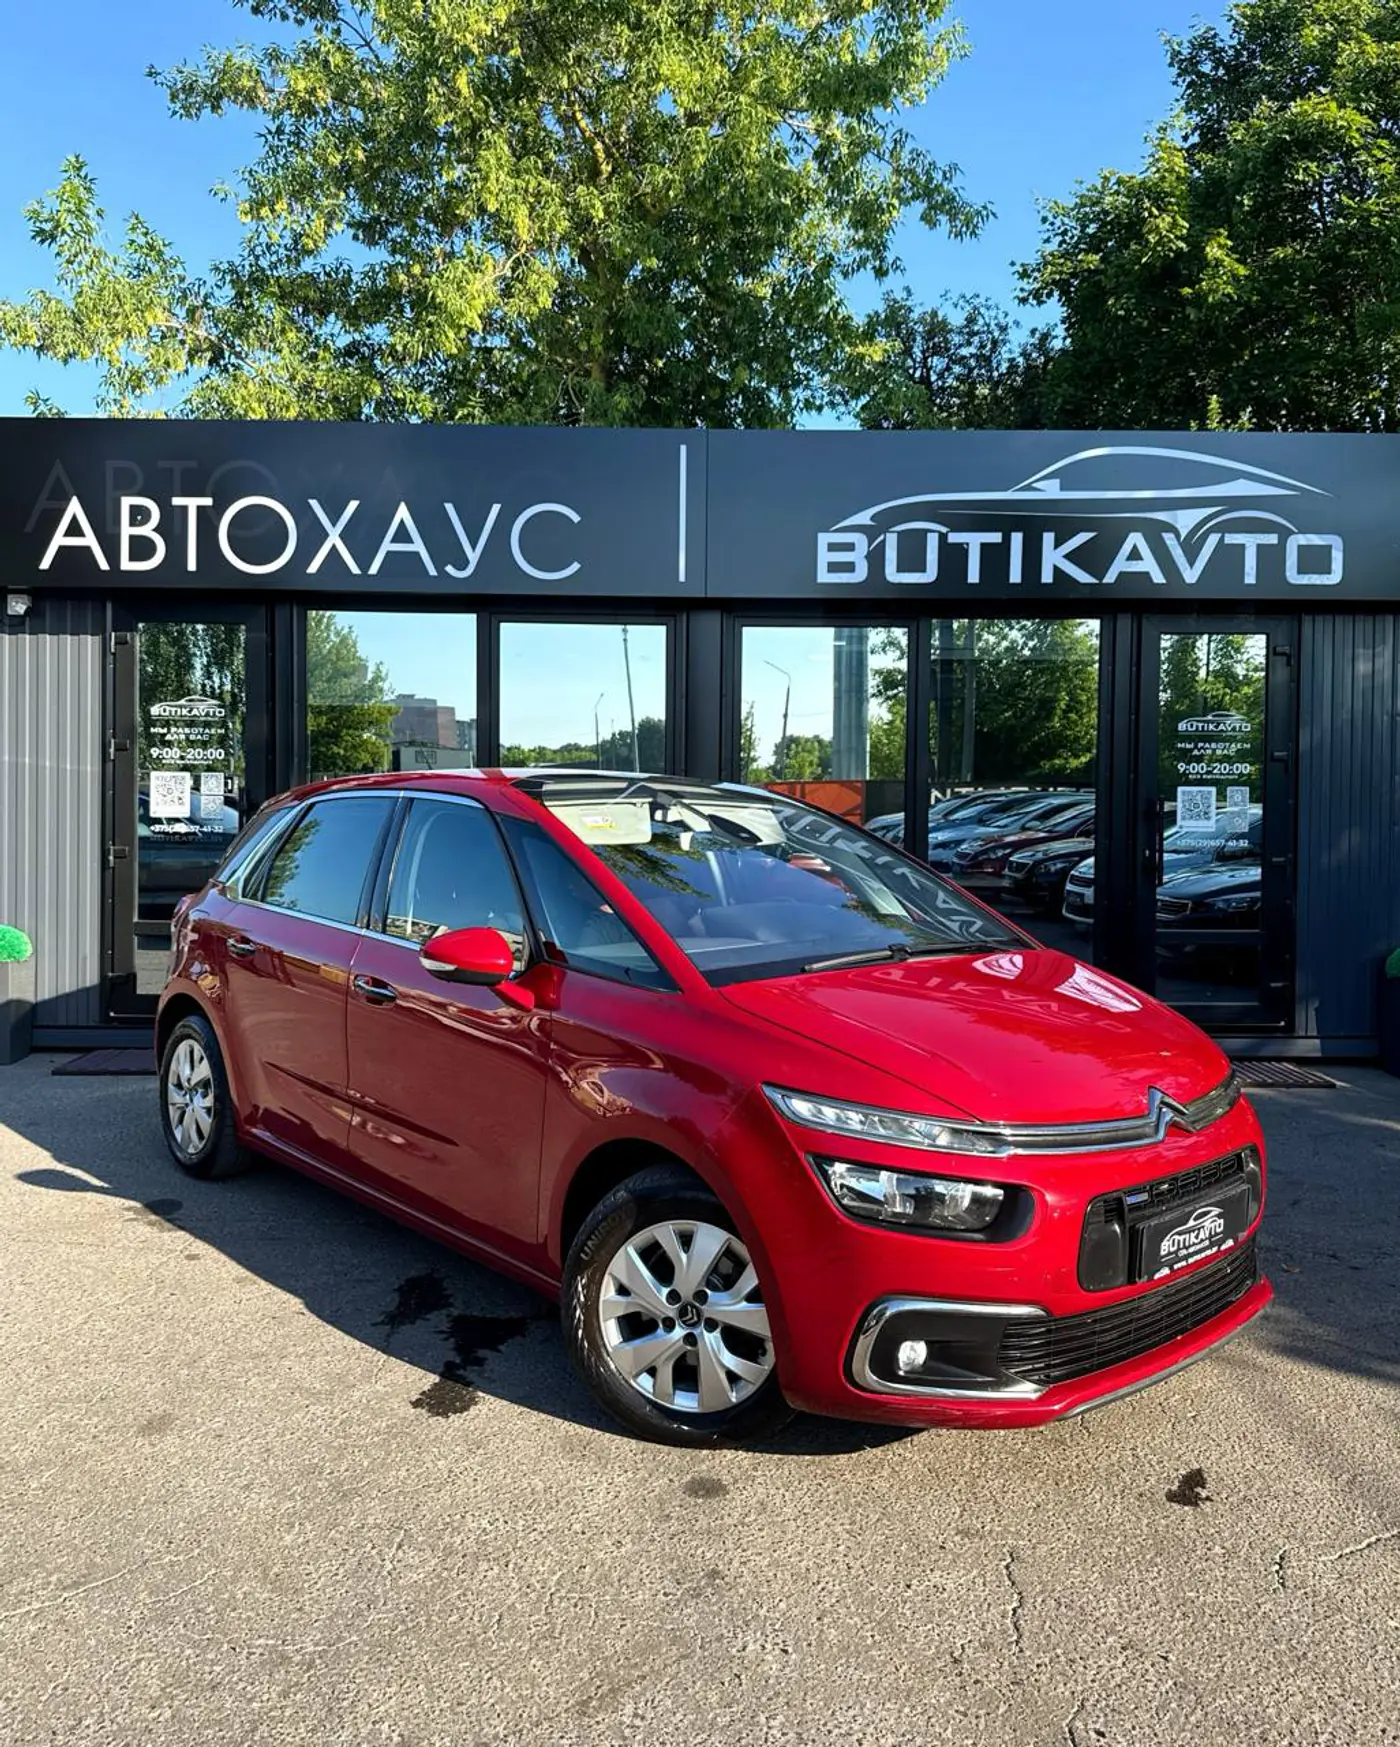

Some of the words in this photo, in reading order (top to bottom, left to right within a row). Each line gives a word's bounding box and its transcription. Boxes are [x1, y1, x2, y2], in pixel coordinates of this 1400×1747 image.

[39, 495, 582, 580] АВТОХАУС
[816, 530, 1344, 585] BUTIKAVTO
[150, 706, 225, 717] BUTIKAVTO
[1177, 722, 1251, 732] BUTIKAVTO
[150, 747, 225, 760] 9:00-20:00
[1177, 762, 1251, 774] 9:00-20:00
[1160, 1218, 1224, 1256] BUTIKAVTO
